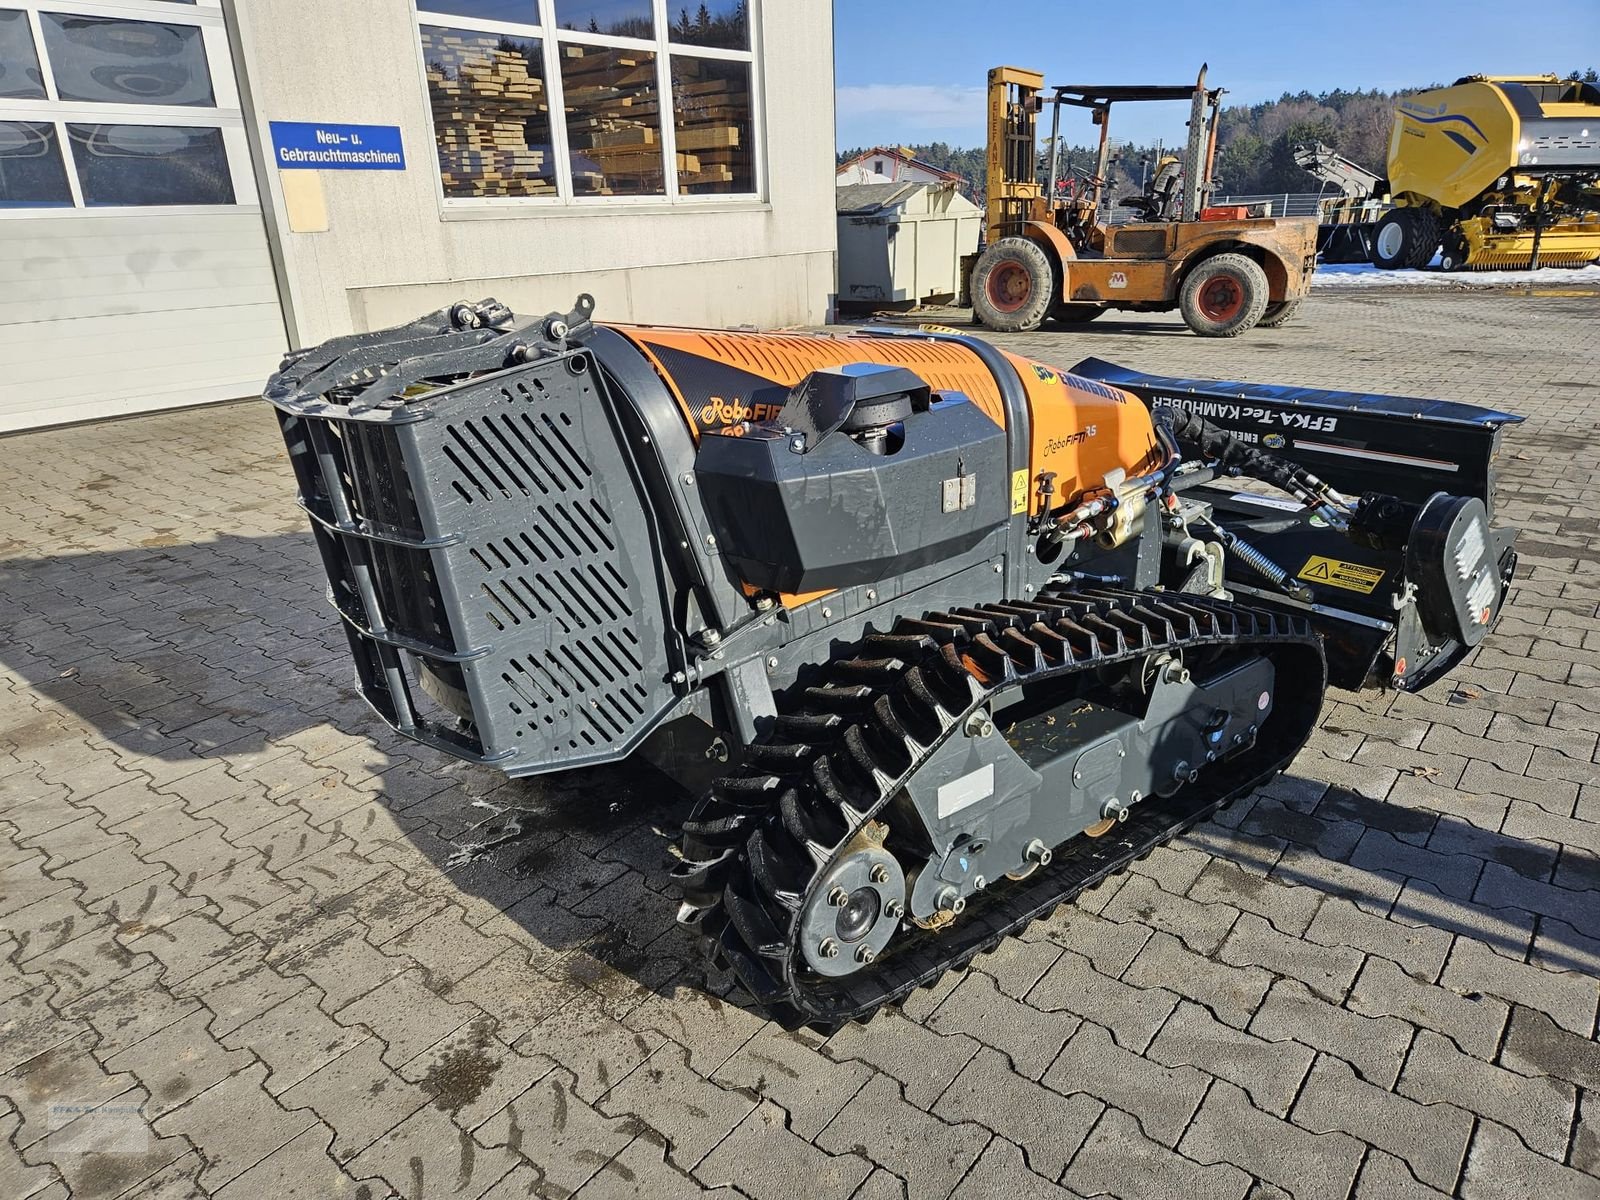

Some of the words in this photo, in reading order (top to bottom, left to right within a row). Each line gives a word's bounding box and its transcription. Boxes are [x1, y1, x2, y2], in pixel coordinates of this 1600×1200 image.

[316, 130, 348, 144] Neu-
[351, 134, 362, 145] u.
[280, 147, 400, 163] Gebrauchtmaschinen
[1152, 396, 1240, 420] KAMHUBER
[1242, 407, 1338, 433] EFKA-Tec
[1339, 575, 1367, 585] WARNING
